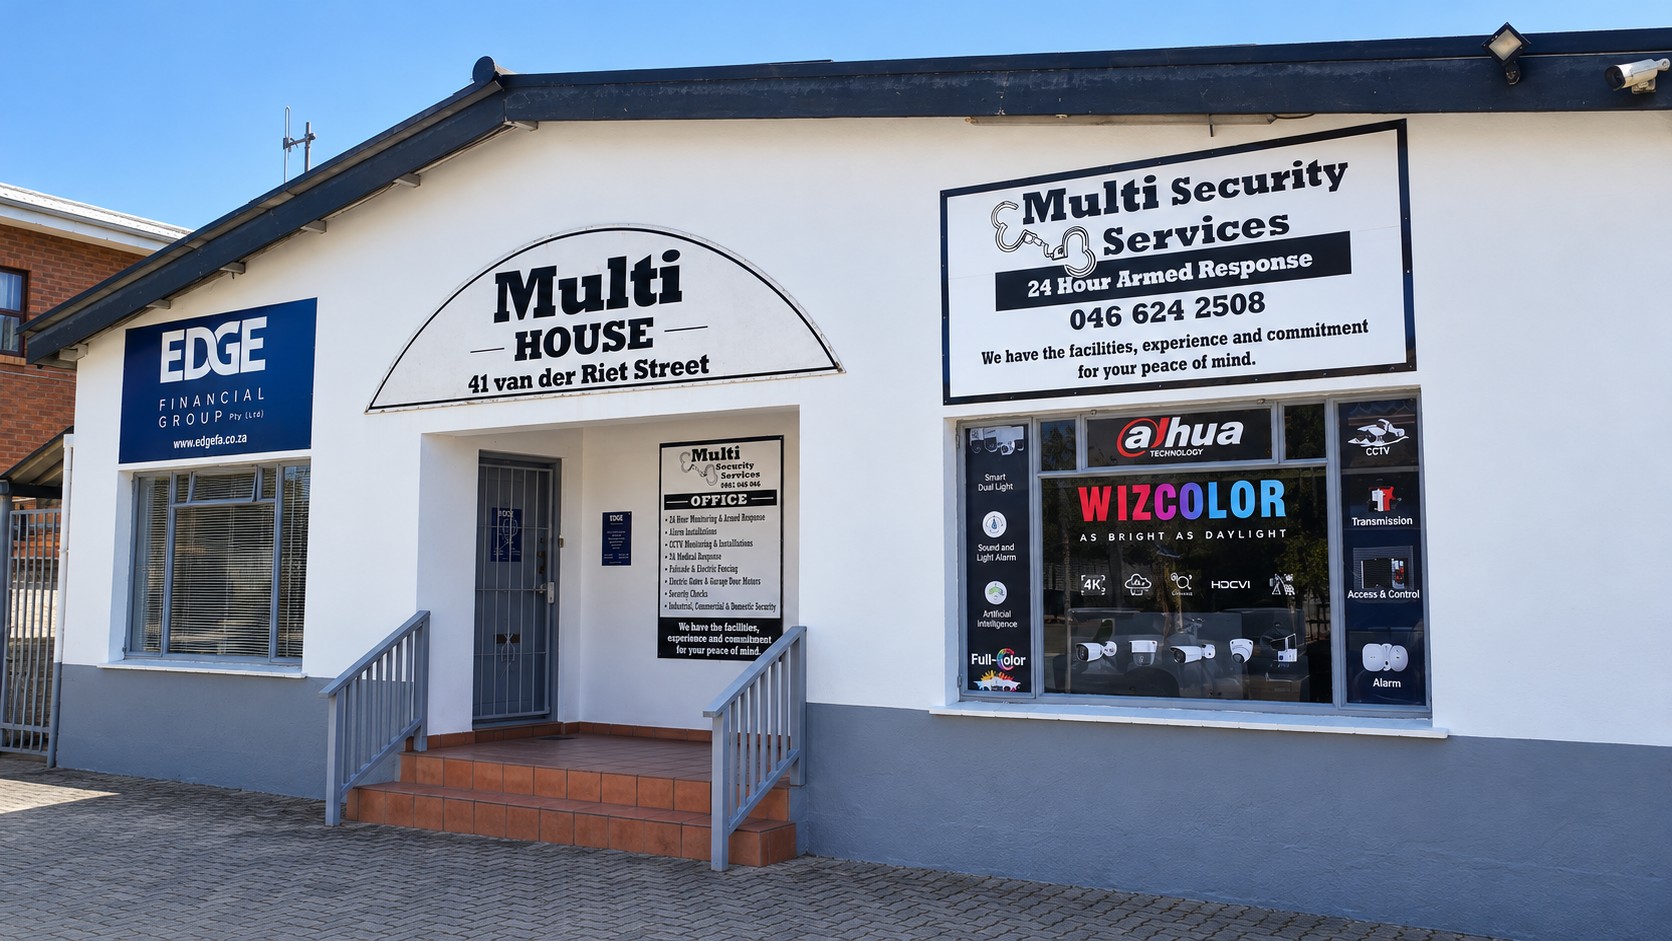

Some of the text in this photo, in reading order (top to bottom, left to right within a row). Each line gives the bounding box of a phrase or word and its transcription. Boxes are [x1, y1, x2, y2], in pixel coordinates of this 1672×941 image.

[1022, 158, 1349, 225] Multi Security
[1103, 213, 1290, 256] Services
[1027, 253, 1313, 298] 24 Hour Armed Response
[493, 249, 683, 324] Multi
[1069, 291, 1266, 331] 046 624 2508
[514, 317, 654, 362] HOUSE
[981, 318, 1370, 365] We have the facilities, experience and commitment
[160, 316, 268, 384] EDGE
[1077, 350, 1256, 381] for your peace of mind.
[468, 354, 710, 394] 41 van der Riet Street
[159, 387, 265, 411] FINANCIAL
[159, 410, 223, 428] GROUP
[229, 413, 242, 421] Pty
[173, 433, 247, 449] www.edgefa.co.za
[691, 445, 741, 462] Multi
[1150, 448, 1204, 458] TECHNOLOGY
[1366, 447, 1390, 456] CCTV
[721, 471, 761, 480] Services
[985, 473, 1006, 481] Smart
[978, 483, 1014, 492] Dual Light
[691, 493, 748, 507] OFFICE
[1078, 479, 1286, 522] WIZCOLOR
[1352, 516, 1412, 526] Transmission
[1080, 528, 1287, 542] AS BRIGHT AS DAYLIGHT
[978, 543, 1015, 552] Sound and
[977, 553, 1017, 563] Light Alarm
[1083, 579, 1101, 590] 4K
[1211, 580, 1251, 589] HDCVI
[1347, 589, 1420, 599] Access & Control
[678, 622, 690, 632] We
[691, 622, 709, 632] have
[710, 622, 722, 632] the
[667, 634, 772, 644] experience and commitment
[676, 646, 687, 654] for
[688, 647, 705, 656] your
[706, 647, 728, 656] peace
[730, 646, 738, 655] of
[1373, 678, 1401, 688] Alarm
